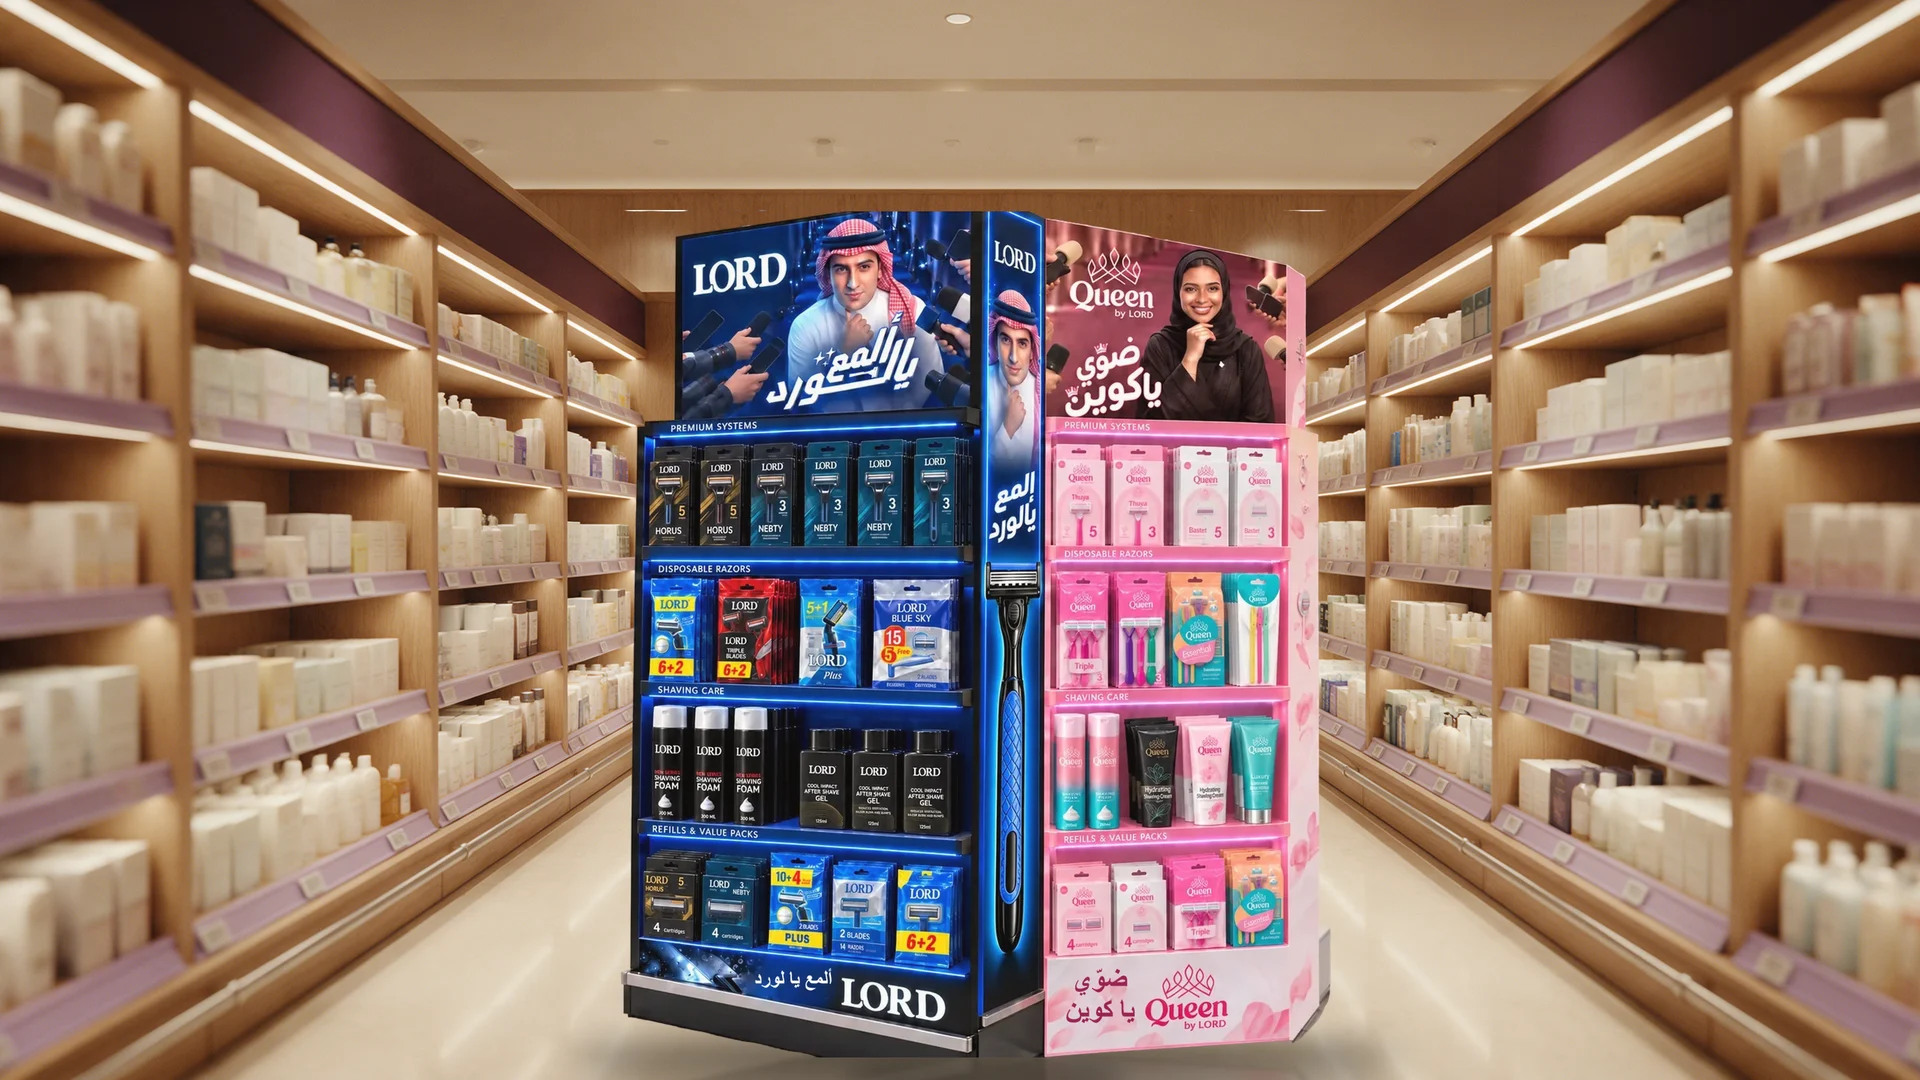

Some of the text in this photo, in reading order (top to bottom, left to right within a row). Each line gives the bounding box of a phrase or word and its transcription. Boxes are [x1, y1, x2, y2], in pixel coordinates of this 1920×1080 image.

[994, 240, 1036, 275] LORD
[693, 253, 787, 295] LORD
[1070, 280, 1154, 311] Queen
[1115, 309, 1153, 318] by LORD
[671, 421, 757, 432] PREMIUM SYSTEMS
[1065, 422, 1150, 431] PREMIUM SYSTEMS
[762, 462, 783, 471] LORD
[815, 461, 837, 470] LORD
[869, 459, 891, 469] LORD
[924, 458, 946, 466] LORD
[659, 465, 680, 473] LORD
[711, 464, 731, 472] LORD
[1069, 474, 1093, 483] Queen
[1126, 475, 1150, 483] Queen
[1193, 476, 1218, 485] Queen
[1249, 477, 1271, 485] Queen
[779, 500, 786, 511] 3
[834, 499, 841, 510] 3
[889, 498, 896, 509] 3
[943, 497, 949, 509] 3
[679, 506, 685, 516] 5
[730, 505, 737, 515] 5
[655, 527, 682, 535] HORUS
[707, 526, 733, 534] HORUS
[814, 524, 838, 532] NEBTY
[867, 523, 892, 531] NEBTY
[1089, 526, 1097, 537] 5
[1148, 526, 1156, 537] 3
[1215, 527, 1221, 538] 5
[1268, 527, 1274, 538] 3
[660, 600, 689, 609] LORD
[732, 601, 757, 610] LORD
[806, 601, 828, 614] 5+1
[897, 603, 927, 613] LORD
[1070, 602, 1095, 612] Queen
[1129, 601, 1153, 609] Queen
[886, 630, 901, 644] 15
[1186, 631, 1211, 640] Queen
[725, 637, 747, 645] LORD
[884, 648, 892, 661] 5
[809, 654, 847, 667] LORD
[658, 661, 684, 674] 6+2
[723, 663, 746, 676] 6+2
[1075, 662, 1094, 670] Triple
[823, 671, 842, 680] Plus
[658, 686, 698, 694] SHAVING
[655, 744, 681, 754] LORD
[697, 746, 722, 756] LORD
[736, 748, 760, 757] LORD
[1146, 748, 1169, 757] Queen
[1198, 746, 1222, 755] Queen
[1248, 746, 1271, 754] Queen
[809, 765, 836, 774] LORD
[860, 767, 887, 776] LORD
[913, 767, 940, 777] LORD
[697, 783, 720, 791] FOAM
[737, 785, 759, 793] FOAM
[652, 825, 686, 834] REFILLS
[700, 828, 727, 836] VALUE
[730, 829, 758, 838] PACKS
[1064, 835, 1095, 843] REFILLS
[645, 875, 668, 884] LORD
[679, 877, 684, 886] 5
[776, 870, 801, 885] 10+4
[709, 880, 730, 888] LORD
[845, 883, 873, 894] LORD
[910, 888, 940, 899] LORD
[1187, 888, 1211, 896] Queen
[1072, 897, 1095, 906] Queen
[1131, 894, 1154, 902] Queen
[1247, 902, 1269, 910] Queen
[653, 923, 660, 932] 4
[712, 928, 719, 938] 4
[785, 933, 809, 943] PLUS
[840, 929, 870, 940] 2 BLADES
[907, 934, 936, 951] 6+2
[1067, 939, 1075, 950] 4
[1125, 937, 1132, 947] 4
[755, 968, 832, 990] ألمع يا لورد
[841, 978, 946, 1021] LORD
[1066, 1001, 1135, 1025] يا كوين
[1145, 999, 1228, 1027] Queen
[1184, 1020, 1226, 1031] by LORD
